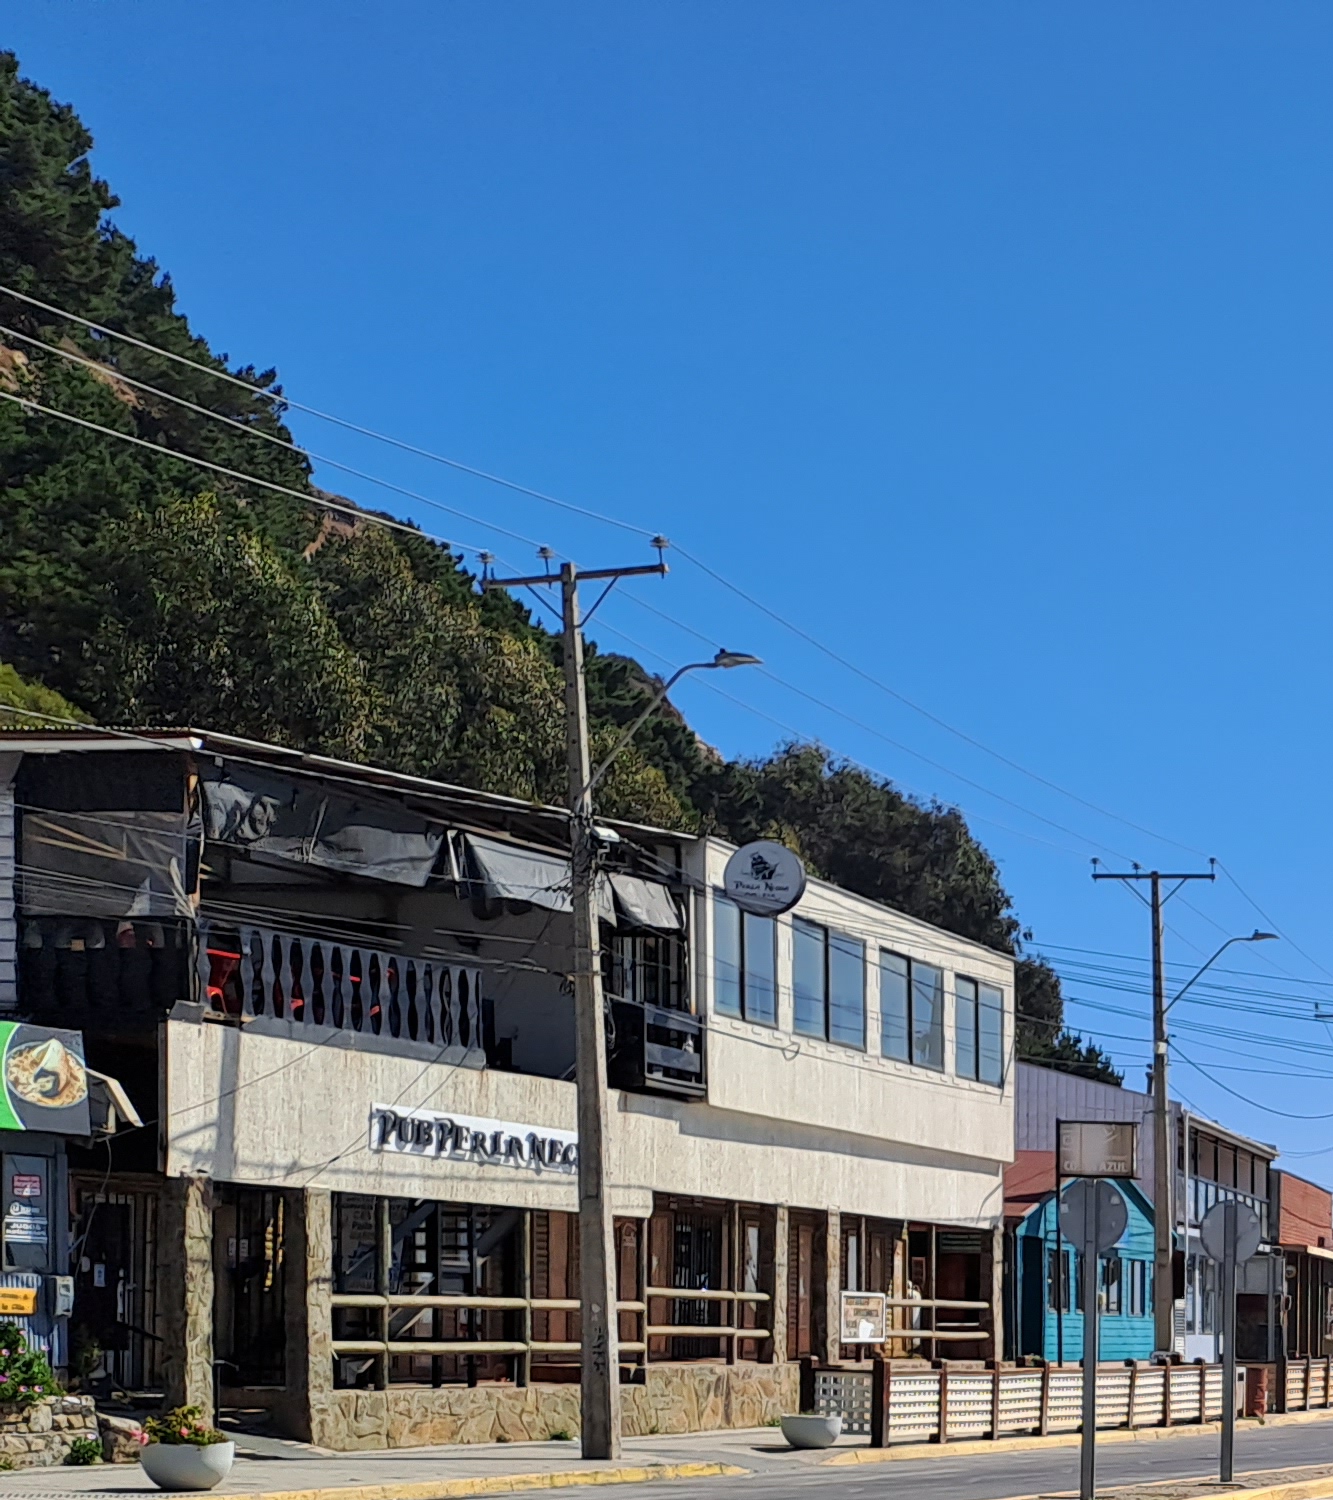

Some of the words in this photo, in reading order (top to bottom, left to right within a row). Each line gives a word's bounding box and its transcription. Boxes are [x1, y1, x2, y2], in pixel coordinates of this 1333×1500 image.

[374, 1108, 433, 1147] PUB
[434, 1117, 526, 1162] PERLA
[527, 1132, 578, 1167] NEG
